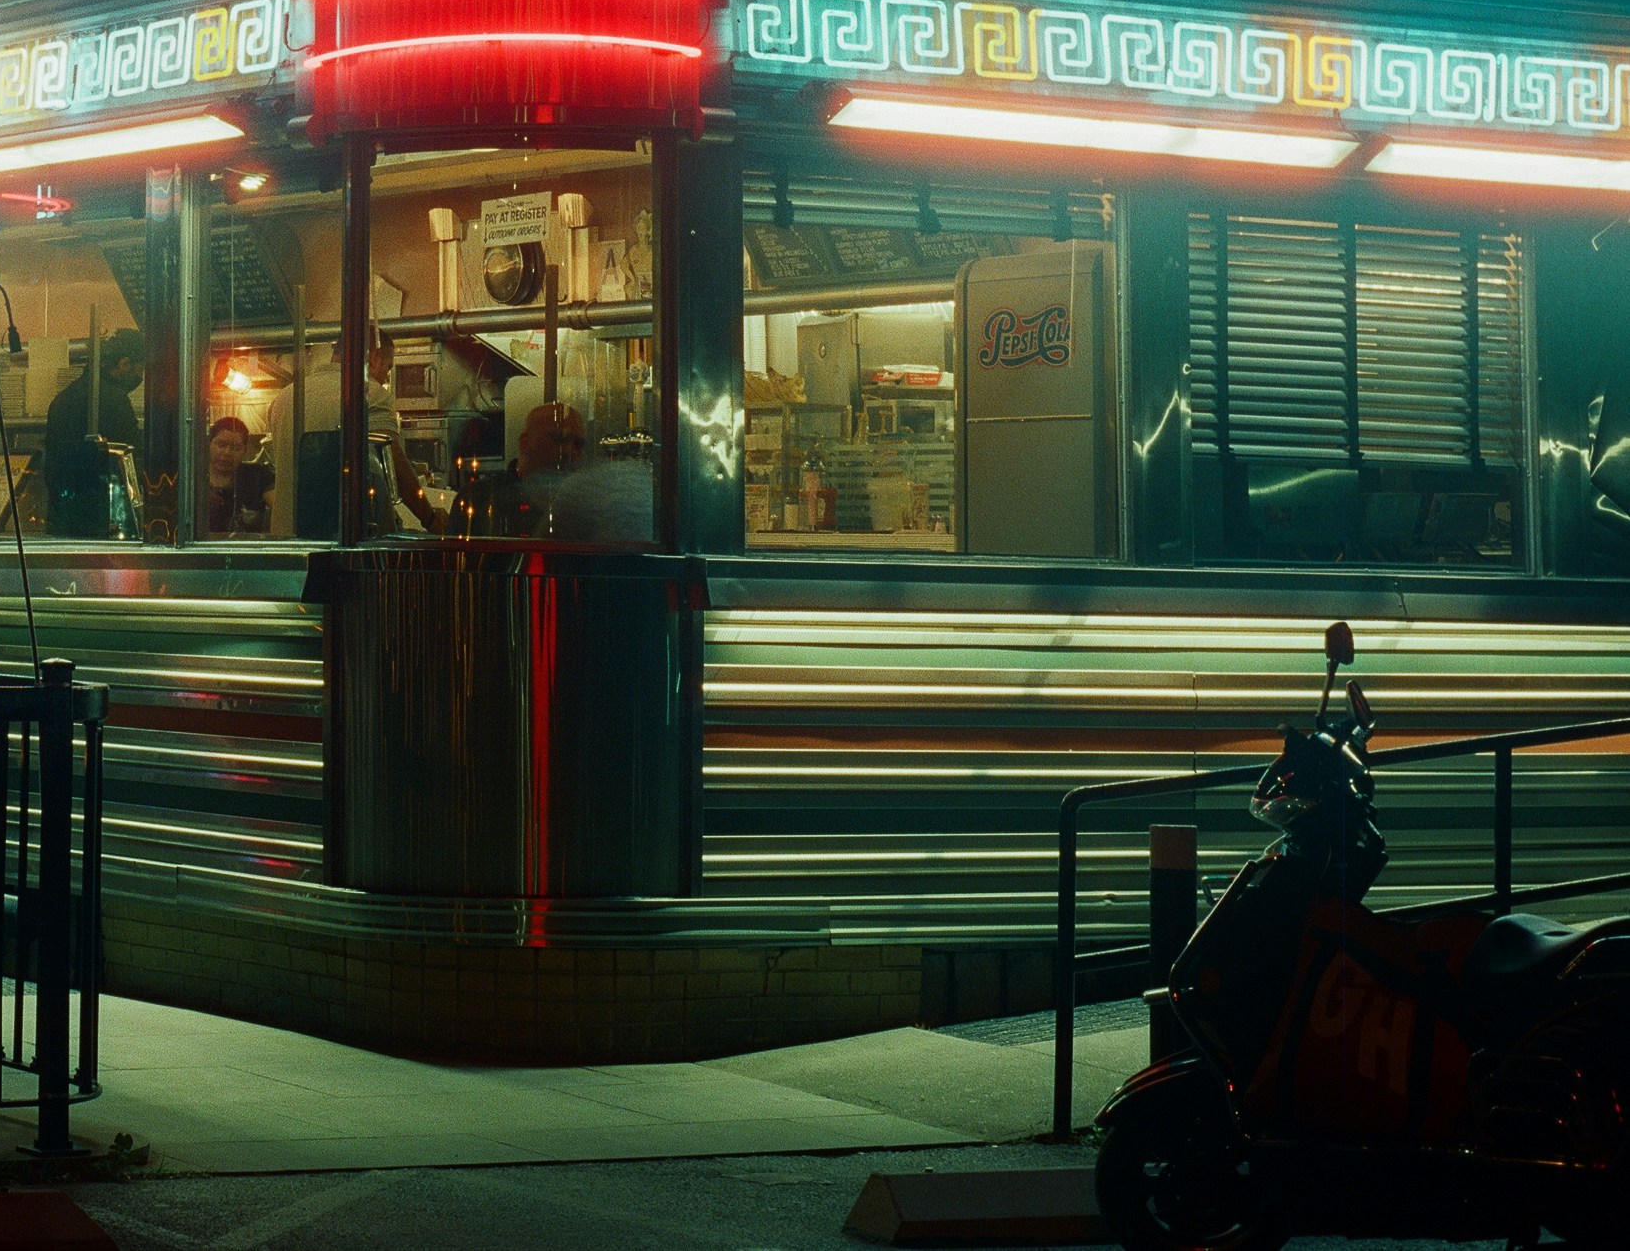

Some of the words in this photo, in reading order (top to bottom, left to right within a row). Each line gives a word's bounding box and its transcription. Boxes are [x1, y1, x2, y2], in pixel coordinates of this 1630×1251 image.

[485, 212, 498, 225] PAY
[499, 210, 509, 223] AT
[510, 206, 547, 222] REGISTER
